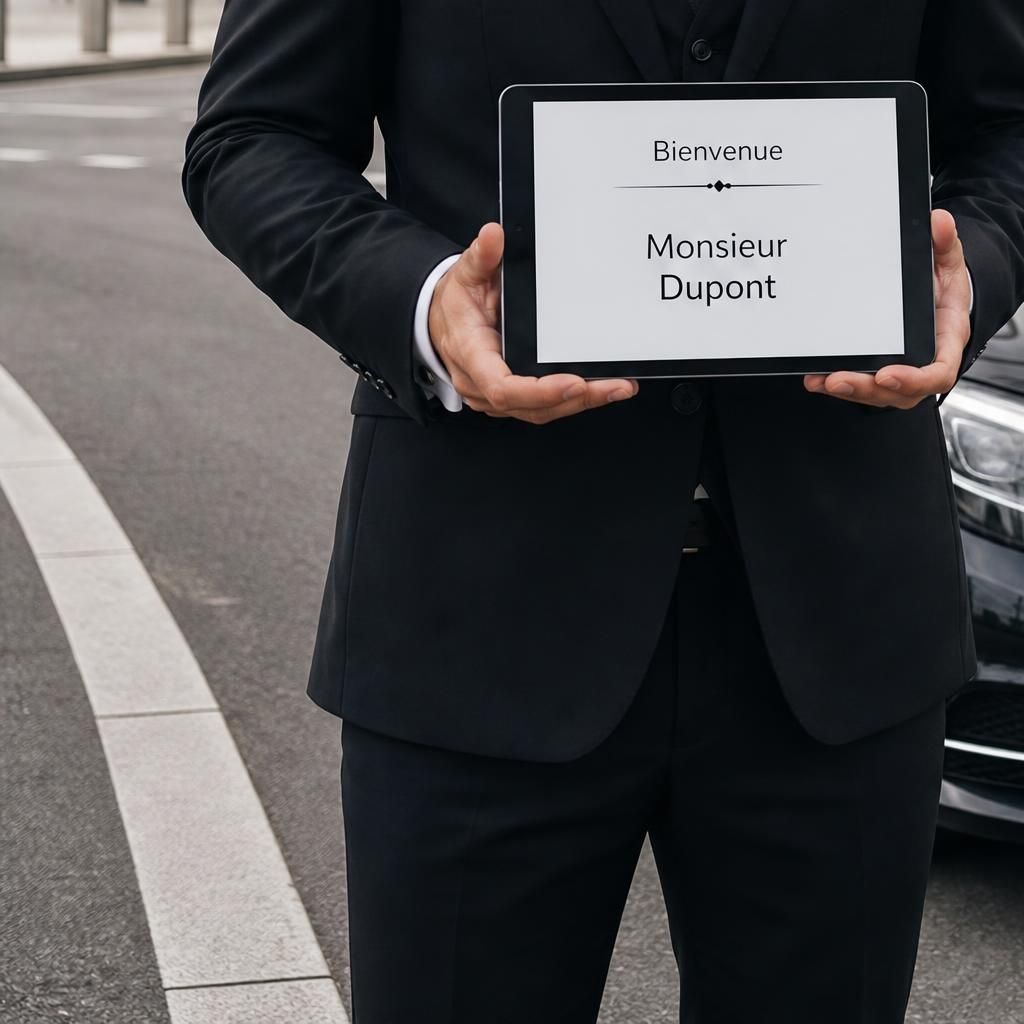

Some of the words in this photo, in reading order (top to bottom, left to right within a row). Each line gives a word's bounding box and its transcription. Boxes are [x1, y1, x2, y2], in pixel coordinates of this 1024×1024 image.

[653, 140, 783, 162] Bienvenue
[646, 233, 788, 260] Monsieur
[660, 274, 777, 307] Dupont
